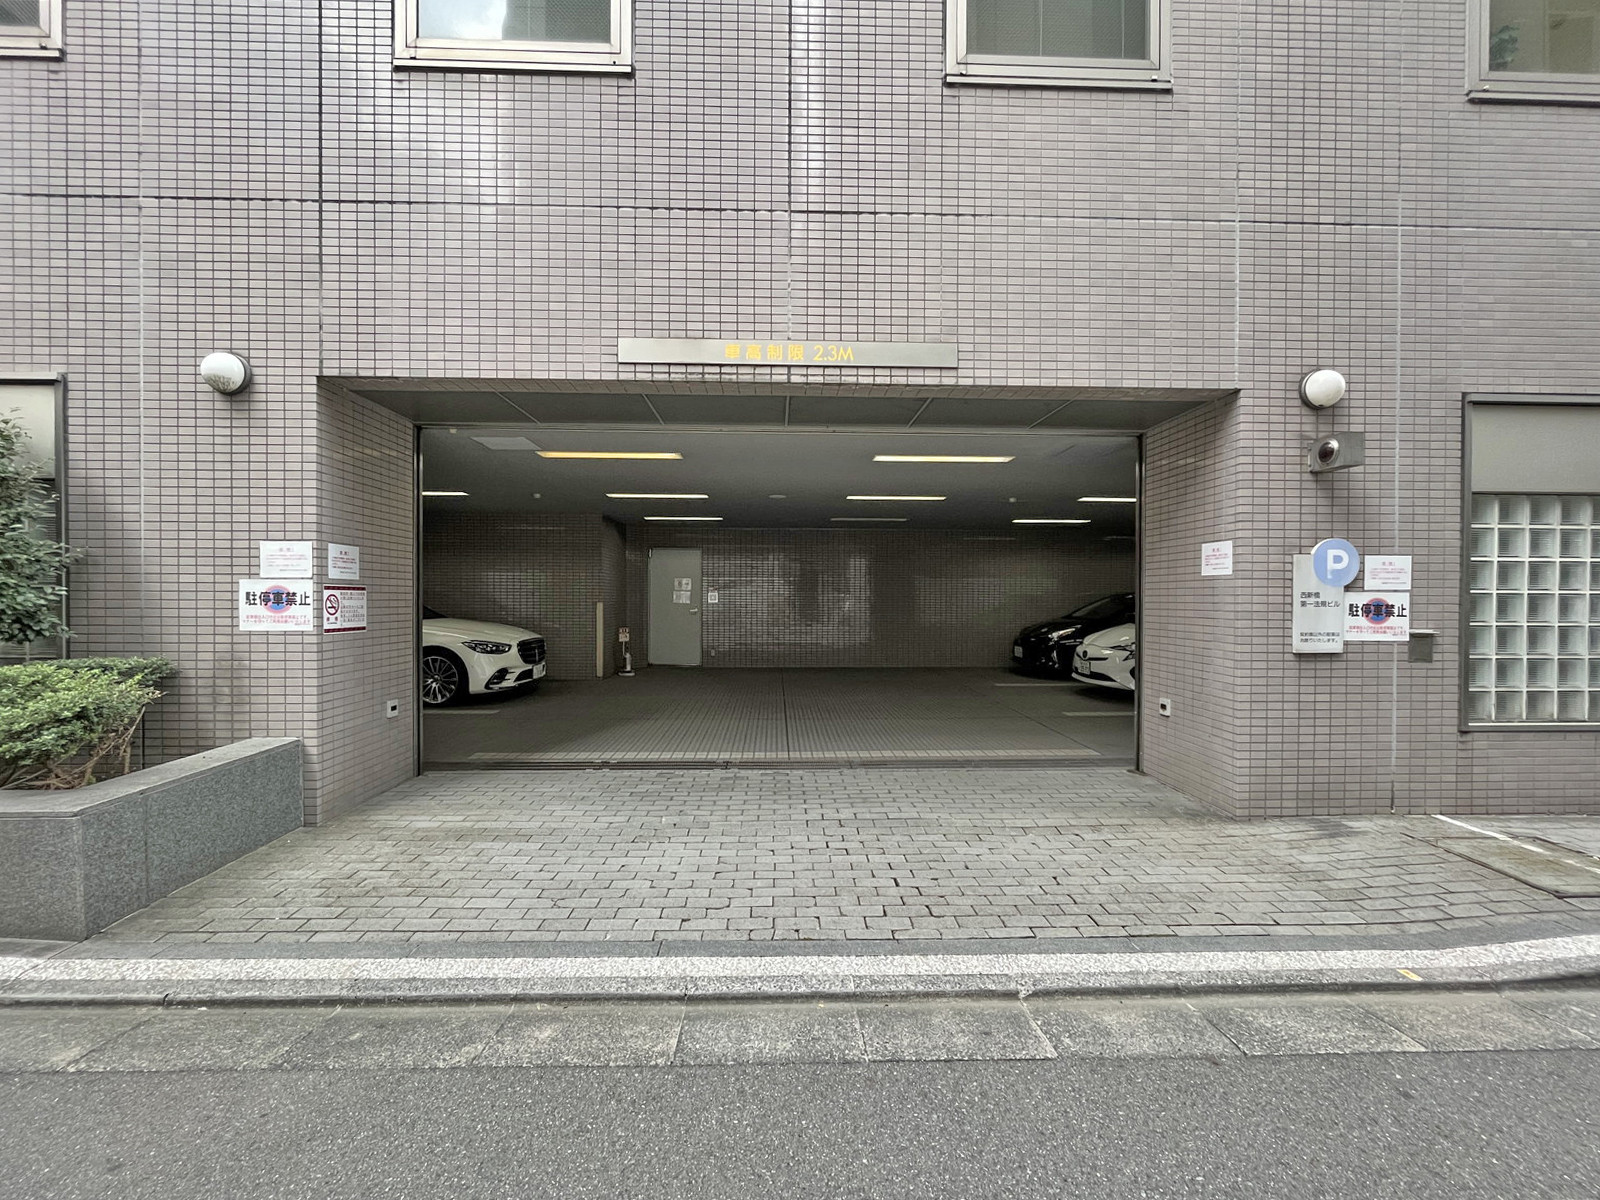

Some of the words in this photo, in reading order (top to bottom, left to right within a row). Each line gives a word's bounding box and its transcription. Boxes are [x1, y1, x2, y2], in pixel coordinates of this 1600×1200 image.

[725, 345, 804, 361] 車高制限
[814, 344, 854, 361] 2.3M
[1327, 549, 1349, 579] P
[246, 592, 310, 606] 駐停車禁止
[1348, 604, 1407, 618] 駐停車禁止
